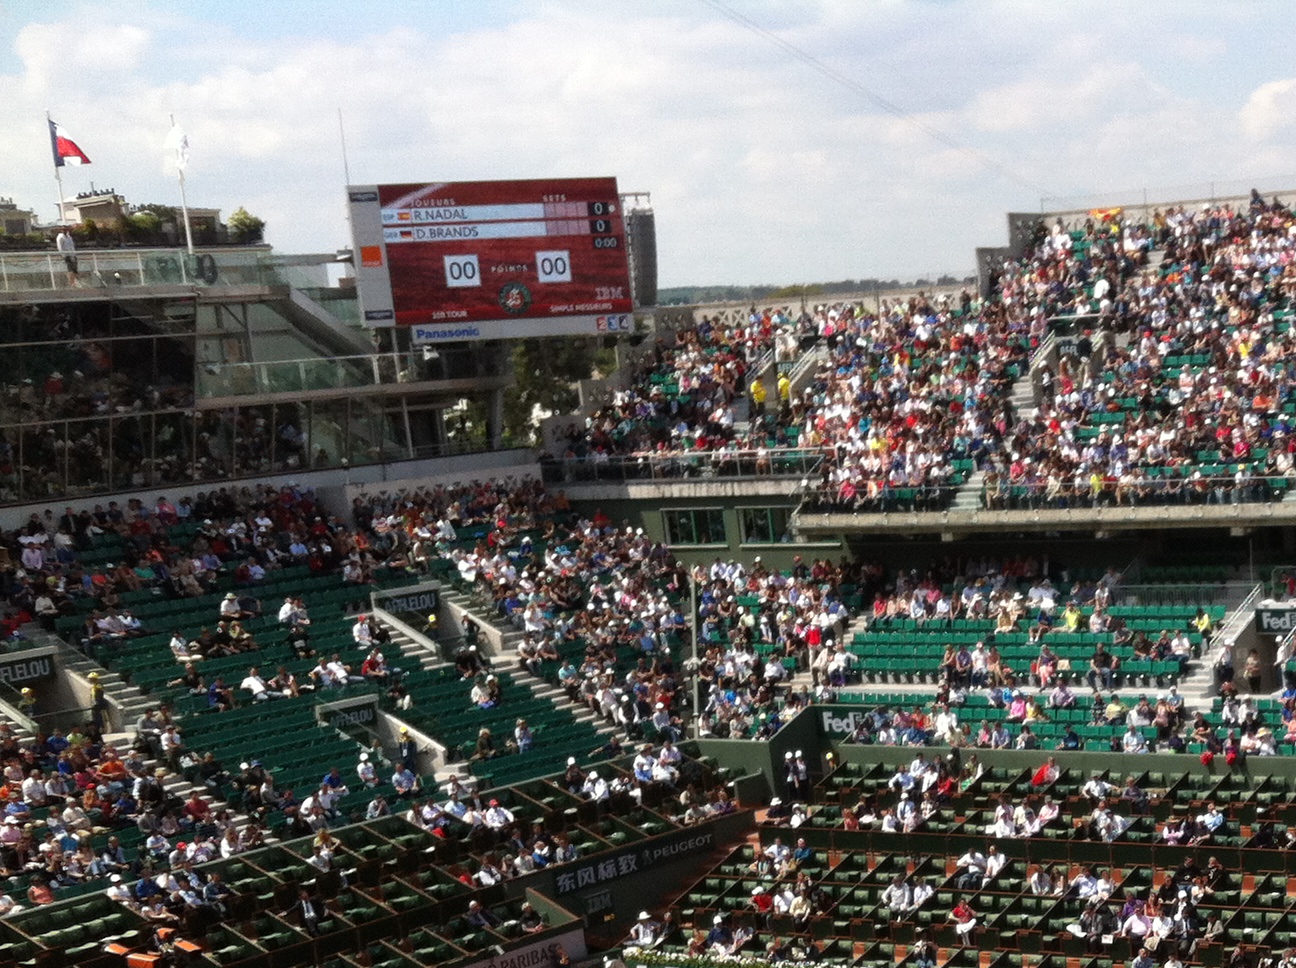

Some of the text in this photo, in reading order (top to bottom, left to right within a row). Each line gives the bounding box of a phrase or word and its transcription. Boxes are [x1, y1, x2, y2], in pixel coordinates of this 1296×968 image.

[413, 208, 468, 221] R.NADAL
[594, 202, 603, 215] 0
[416, 227, 479, 239] D.BRANDS
[596, 220, 605, 232] 0
[450, 261, 476, 280] 00
[541, 257, 567, 276] 00
[595, 286, 623, 300] IBM
[416, 326, 480, 340] Panasonic
[653, 833, 713, 860] PEUGEOT
[556, 853, 639, 894] 东风标致
